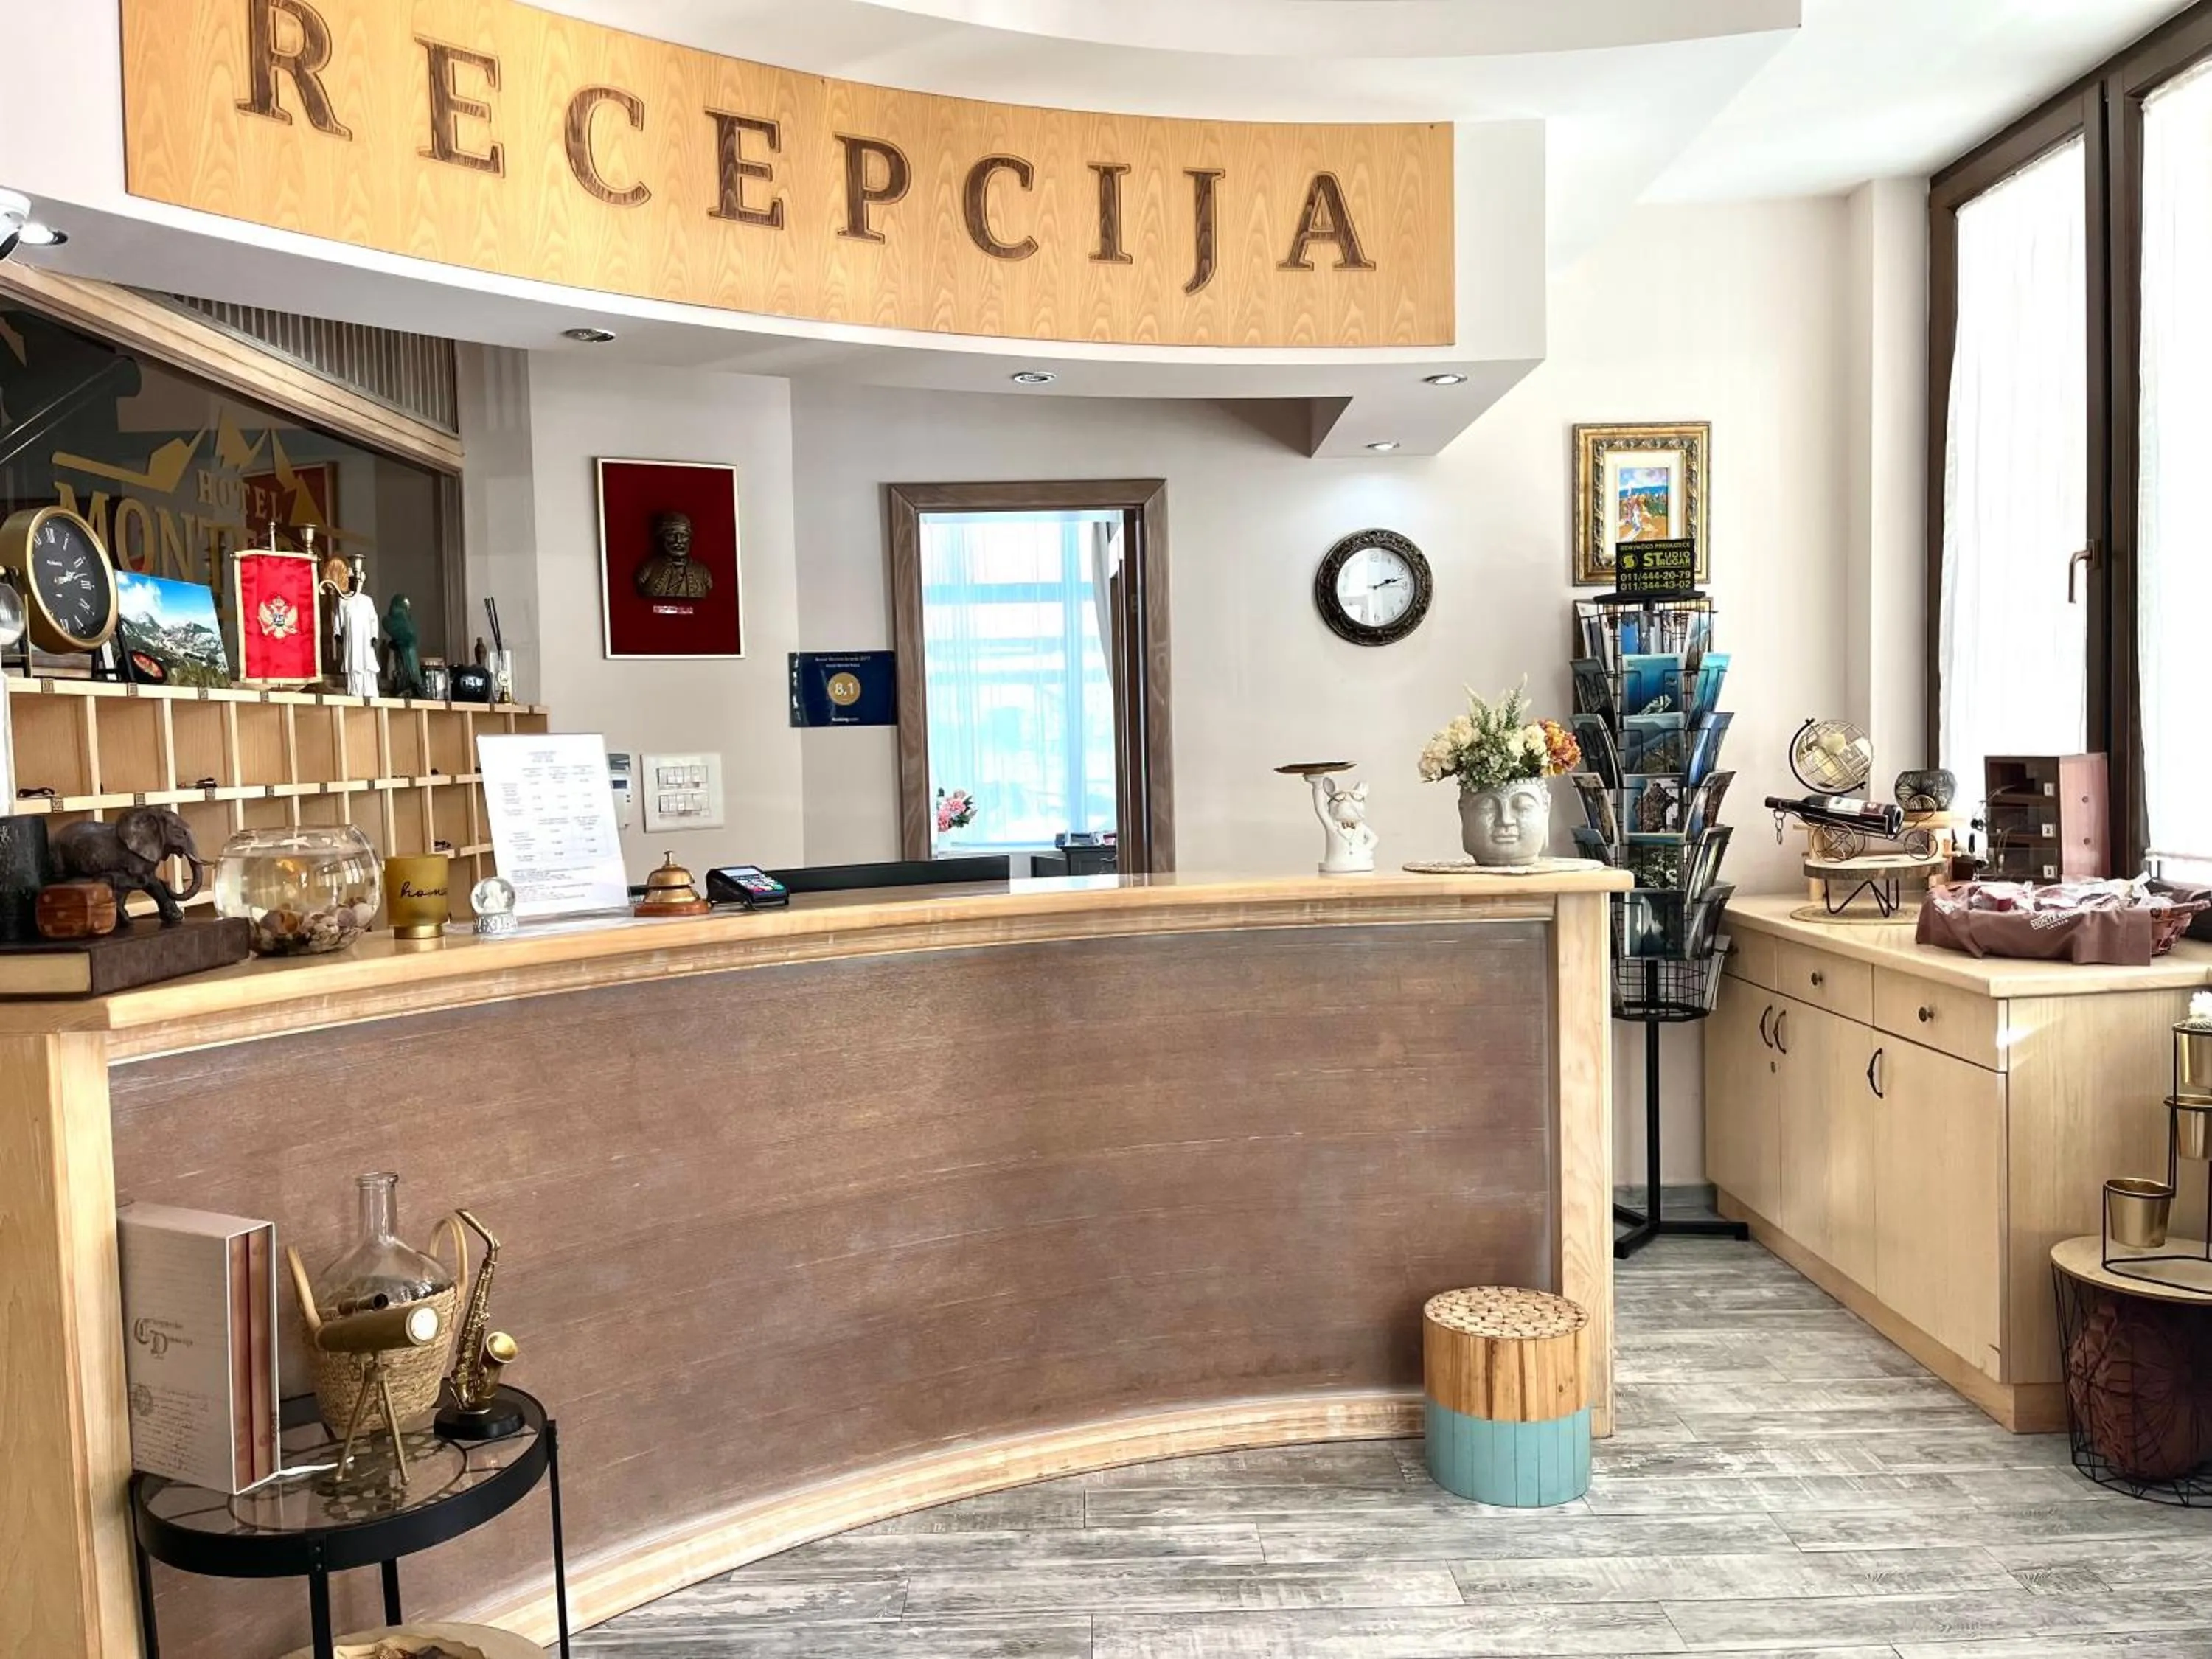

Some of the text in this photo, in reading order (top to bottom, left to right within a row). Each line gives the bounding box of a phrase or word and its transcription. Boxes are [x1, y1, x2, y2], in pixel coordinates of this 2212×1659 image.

[235, 0, 1376, 296] RECEPCIJA
[198, 469, 283, 522] HOTEL
[835, 682, 854, 696] 8,1
